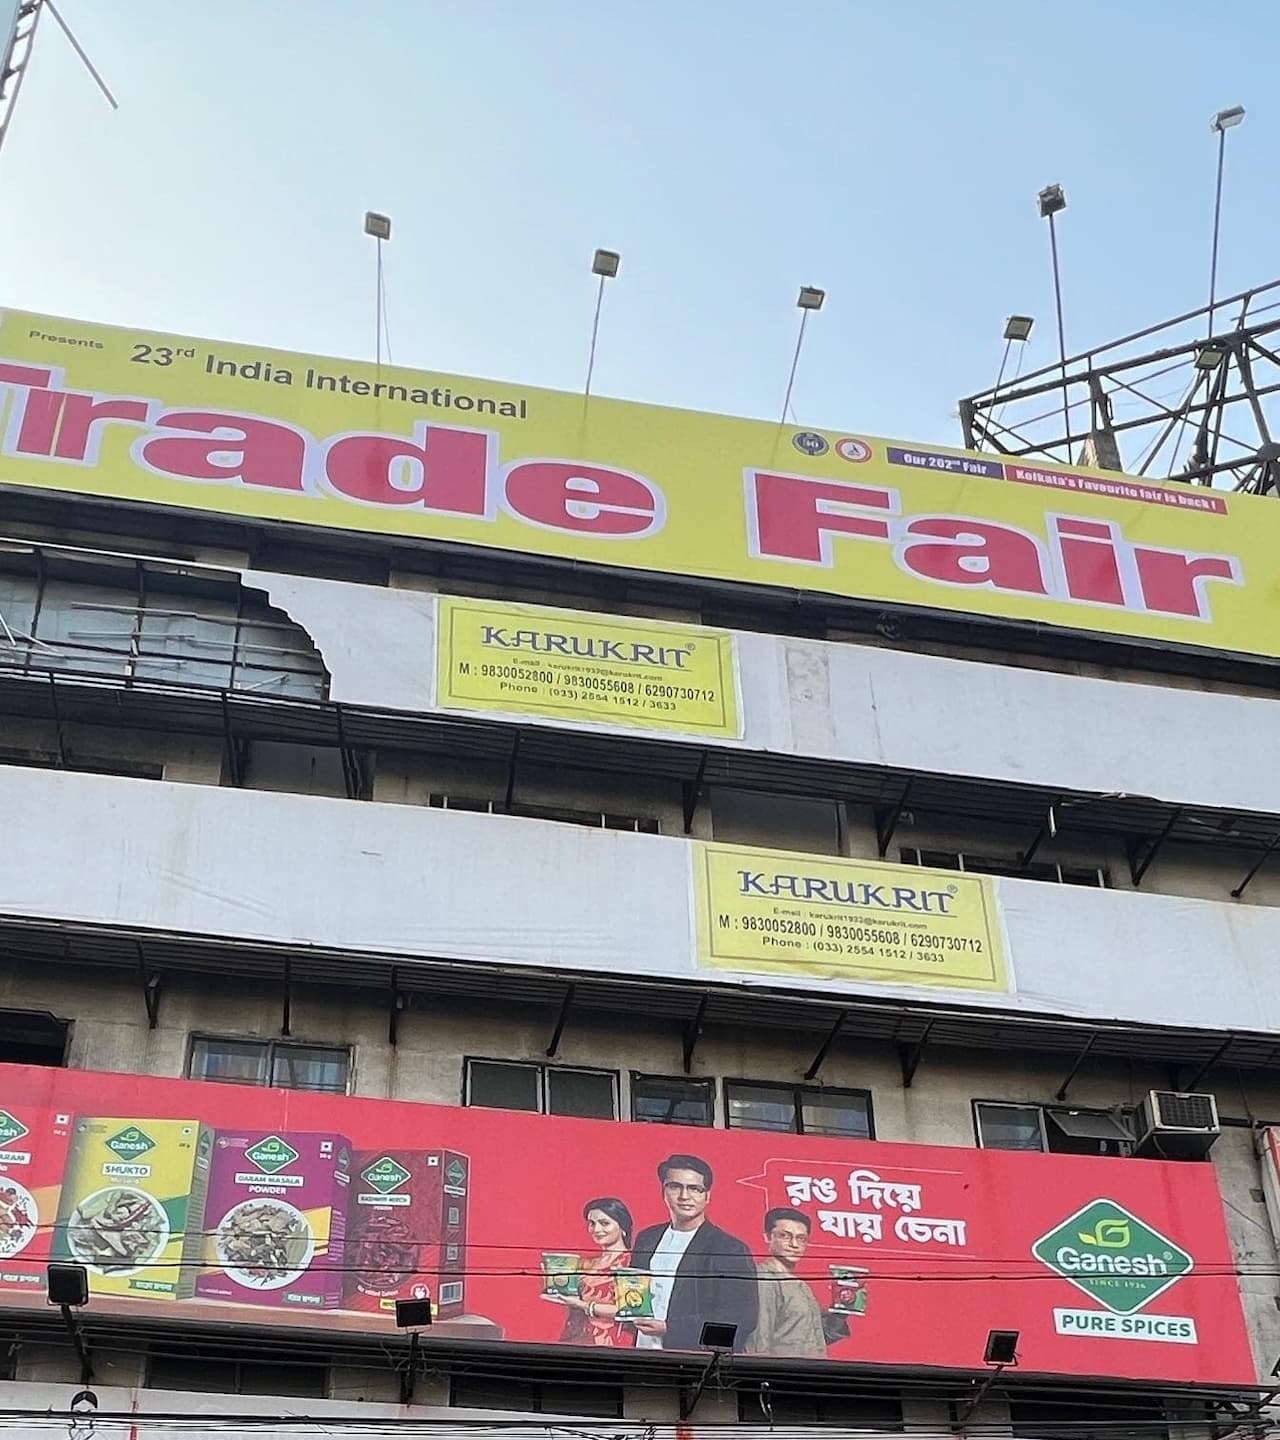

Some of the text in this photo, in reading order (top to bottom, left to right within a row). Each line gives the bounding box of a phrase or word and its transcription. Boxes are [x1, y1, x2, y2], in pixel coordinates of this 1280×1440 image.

[29, 330, 104, 350] Presents
[131, 343, 528, 420] 23rd India International
[903, 453, 927, 466] Our
[962, 461, 988, 475] Fair
[1016, 469, 1076, 489] Kolkata's
[755, 471, 1234, 619] Fair
[459, 662, 470, 675] M
[481, 664, 553, 684] 9830052800
[564, 674, 635, 694] 9830055608
[645, 684, 715, 703] 6290730712
[500, 682, 538, 693] Phone
[719, 914, 730, 929] M
[742, 916, 816, 937] 9830052800
[827, 924, 901, 945] 9830055608
[910, 933, 983, 953] 6290730712
[762, 936, 802, 949] Phone
[813, 942, 843, 955] (033)
[879, 948, 907, 960] 1512
[110, 1140, 149, 1150] Ganesh
[252, 1151, 290, 1162] Ganesh
[104, 1165, 148, 1176] SHUKTO
[367, 1172, 403, 1182] Ganesh
[248, 1185, 287, 1195] POWDER
[784, 1169, 922, 1213] রঙ দিয়ে
[817, 1210, 966, 1246] যায় চেনা
[1056, 1246, 1168, 1276] Ganesh
[1089, 1278, 1120, 1288] SINCE
[1062, 1314, 1191, 1337] PURE SPICES
